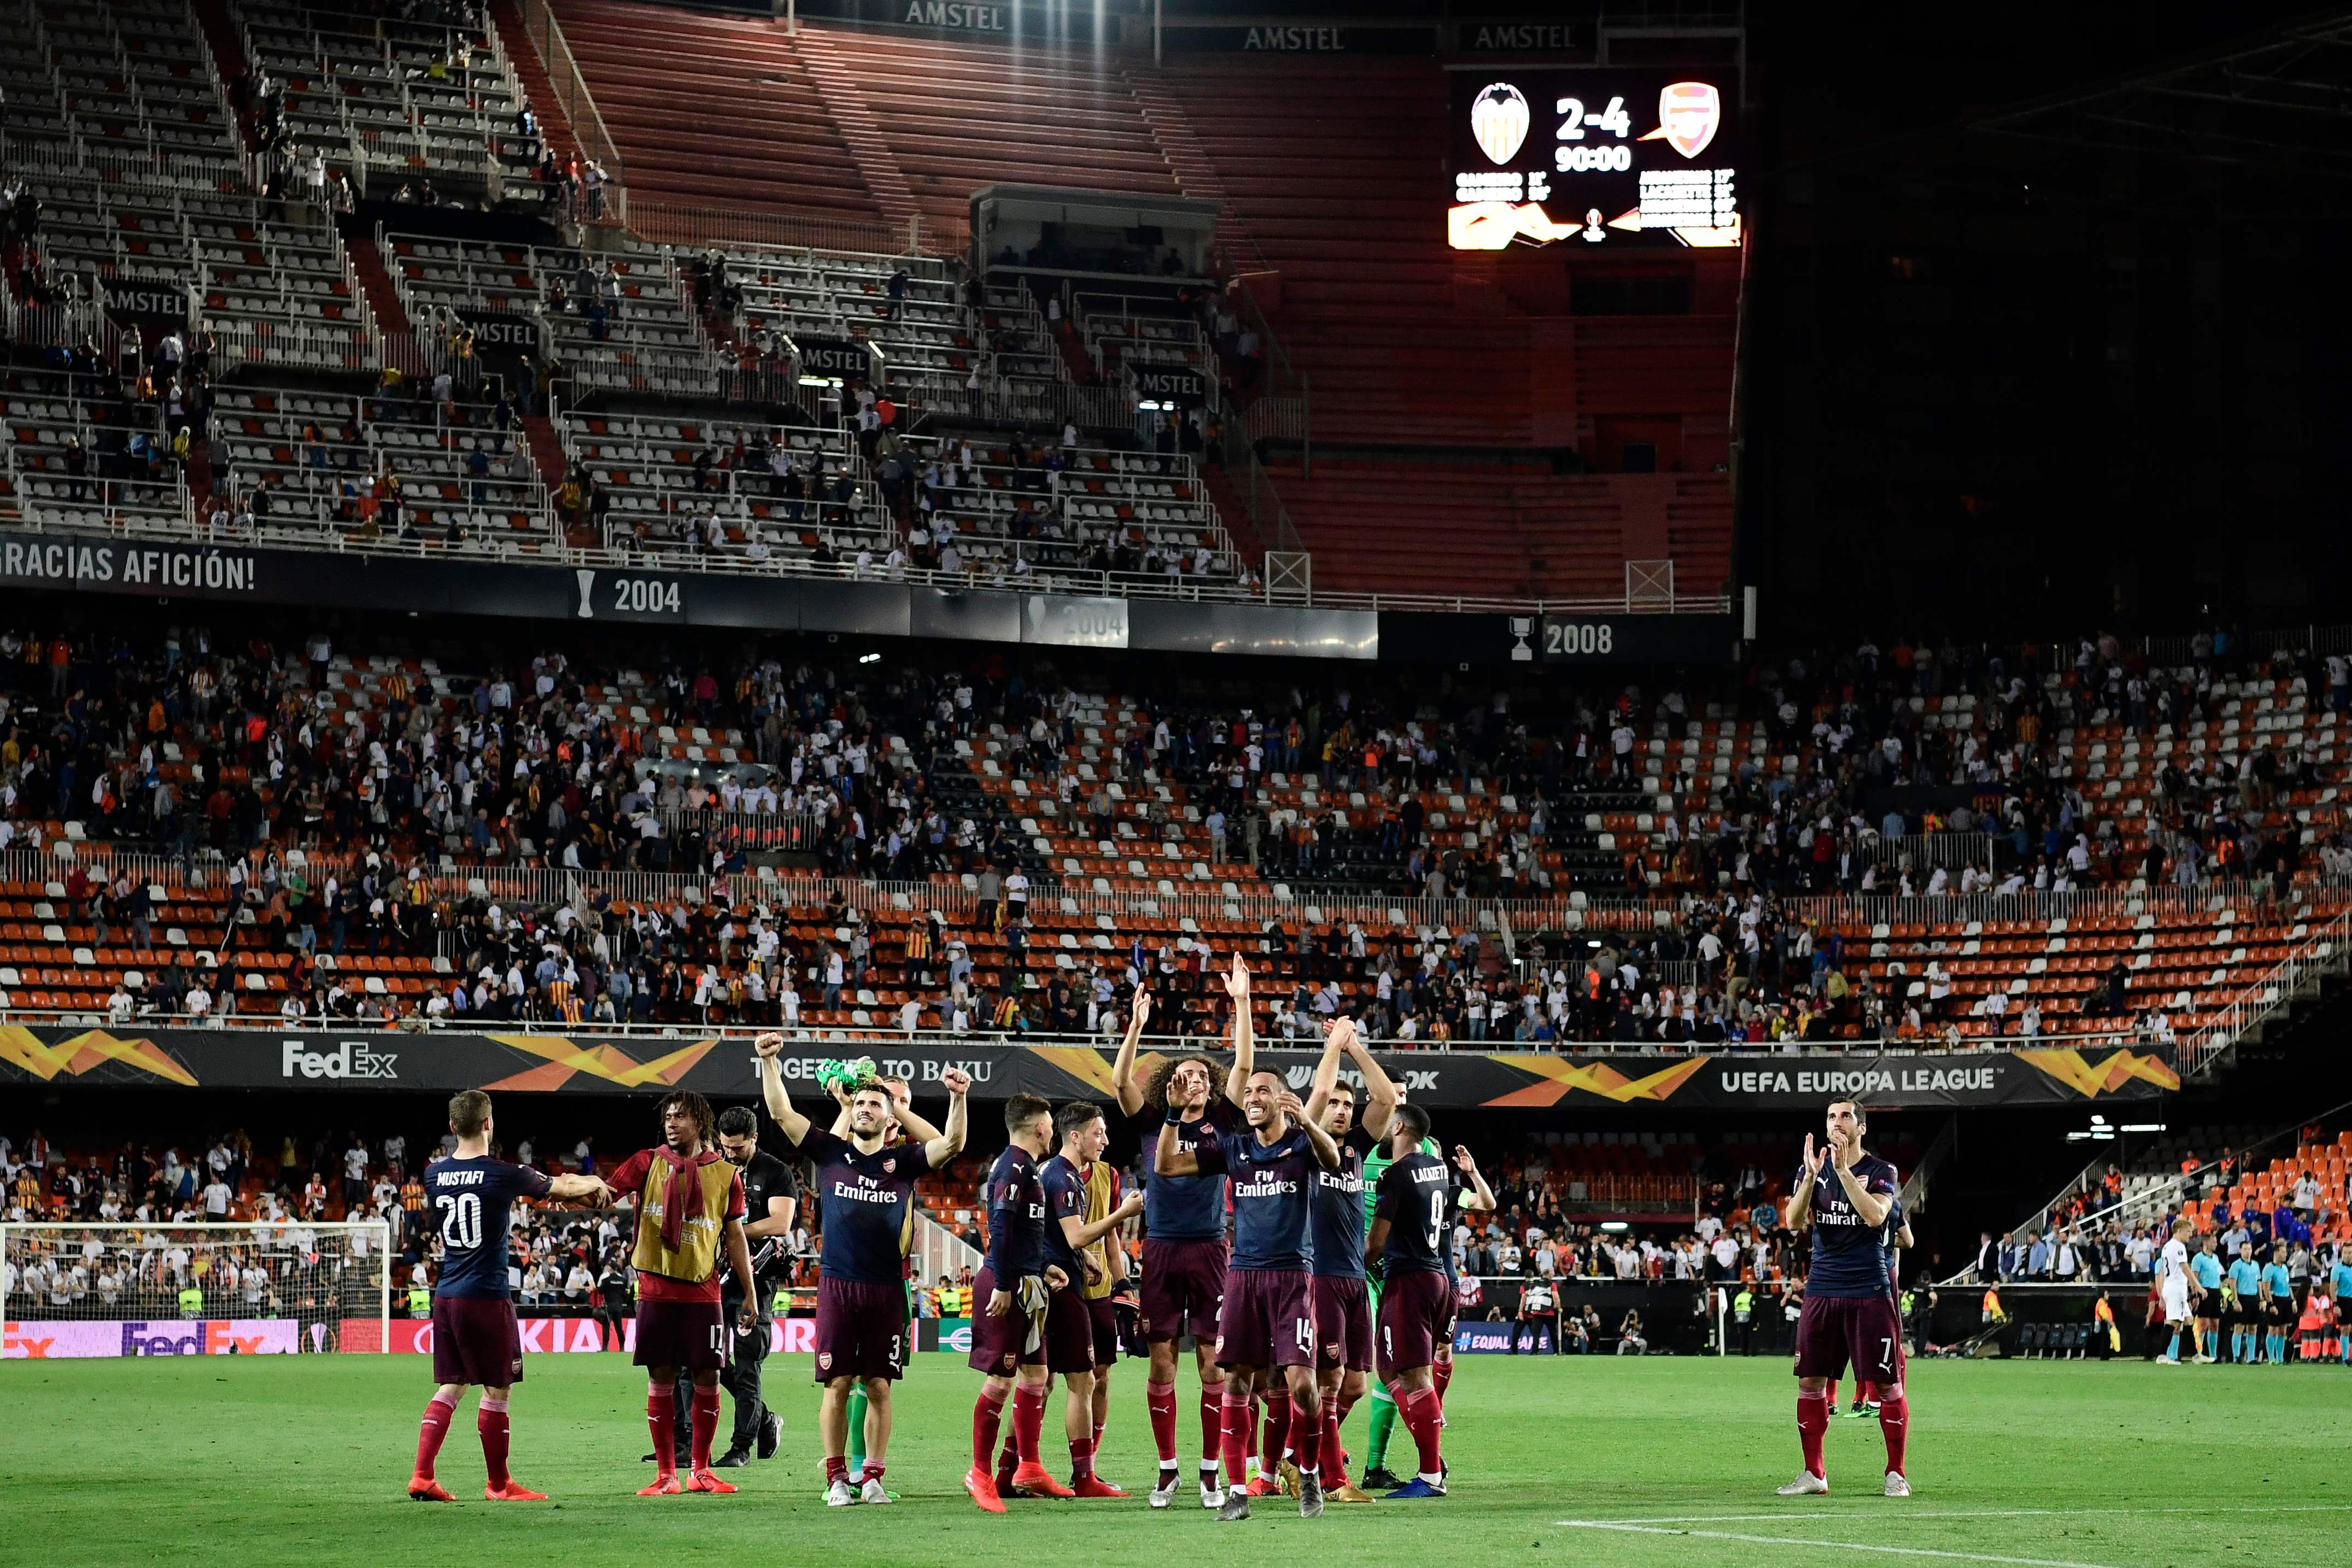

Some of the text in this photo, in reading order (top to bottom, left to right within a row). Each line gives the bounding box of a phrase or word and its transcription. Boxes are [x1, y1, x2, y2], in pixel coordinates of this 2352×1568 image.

[905, 1, 1004, 30] AMSTEL
[1243, 27, 1345, 50] AMSTEL
[1475, 25, 1575, 49] AMSTEL
[1555, 145, 1631, 172] 90:00
[103, 288, 186, 315] AMSTEL
[472, 320, 535, 345] MSTEL
[805, 348, 866, 371] MSTEL
[1143, 373, 1202, 394] MSTEL
[0, 542, 254, 590] RACIAS AFICIÓN!
[615, 579, 681, 612] 2004
[1547, 624, 1612, 654] 2008
[283, 1040, 397, 1079] FedEx
[882, 1060, 915, 1081] TO
[1722, 1067, 1994, 1092] UEFA EUROPA LEAGUE
[436, 1171, 485, 1186] MUSTAFI
[858, 1175, 878, 1189] Fly
[1236, 1180, 1297, 1197] Emirates
[1255, 1170, 1274, 1182] Fly
[834, 1181, 898, 1203] Emirates
[1830, 1200, 1849, 1213] Fly
[436, 1192, 482, 1249] 20
[1429, 1190, 1443, 1249] 9
[121, 1321, 266, 1356] FedEx
[518, 1319, 602, 1353] KIA
[710, 1325, 723, 1349] 17
[1296, 1318, 1313, 1347] 14
[1384, 1325, 1392, 1350] 9
[889, 1335, 900, 1360] 3
[1881, 1338, 1892, 1363] 7
